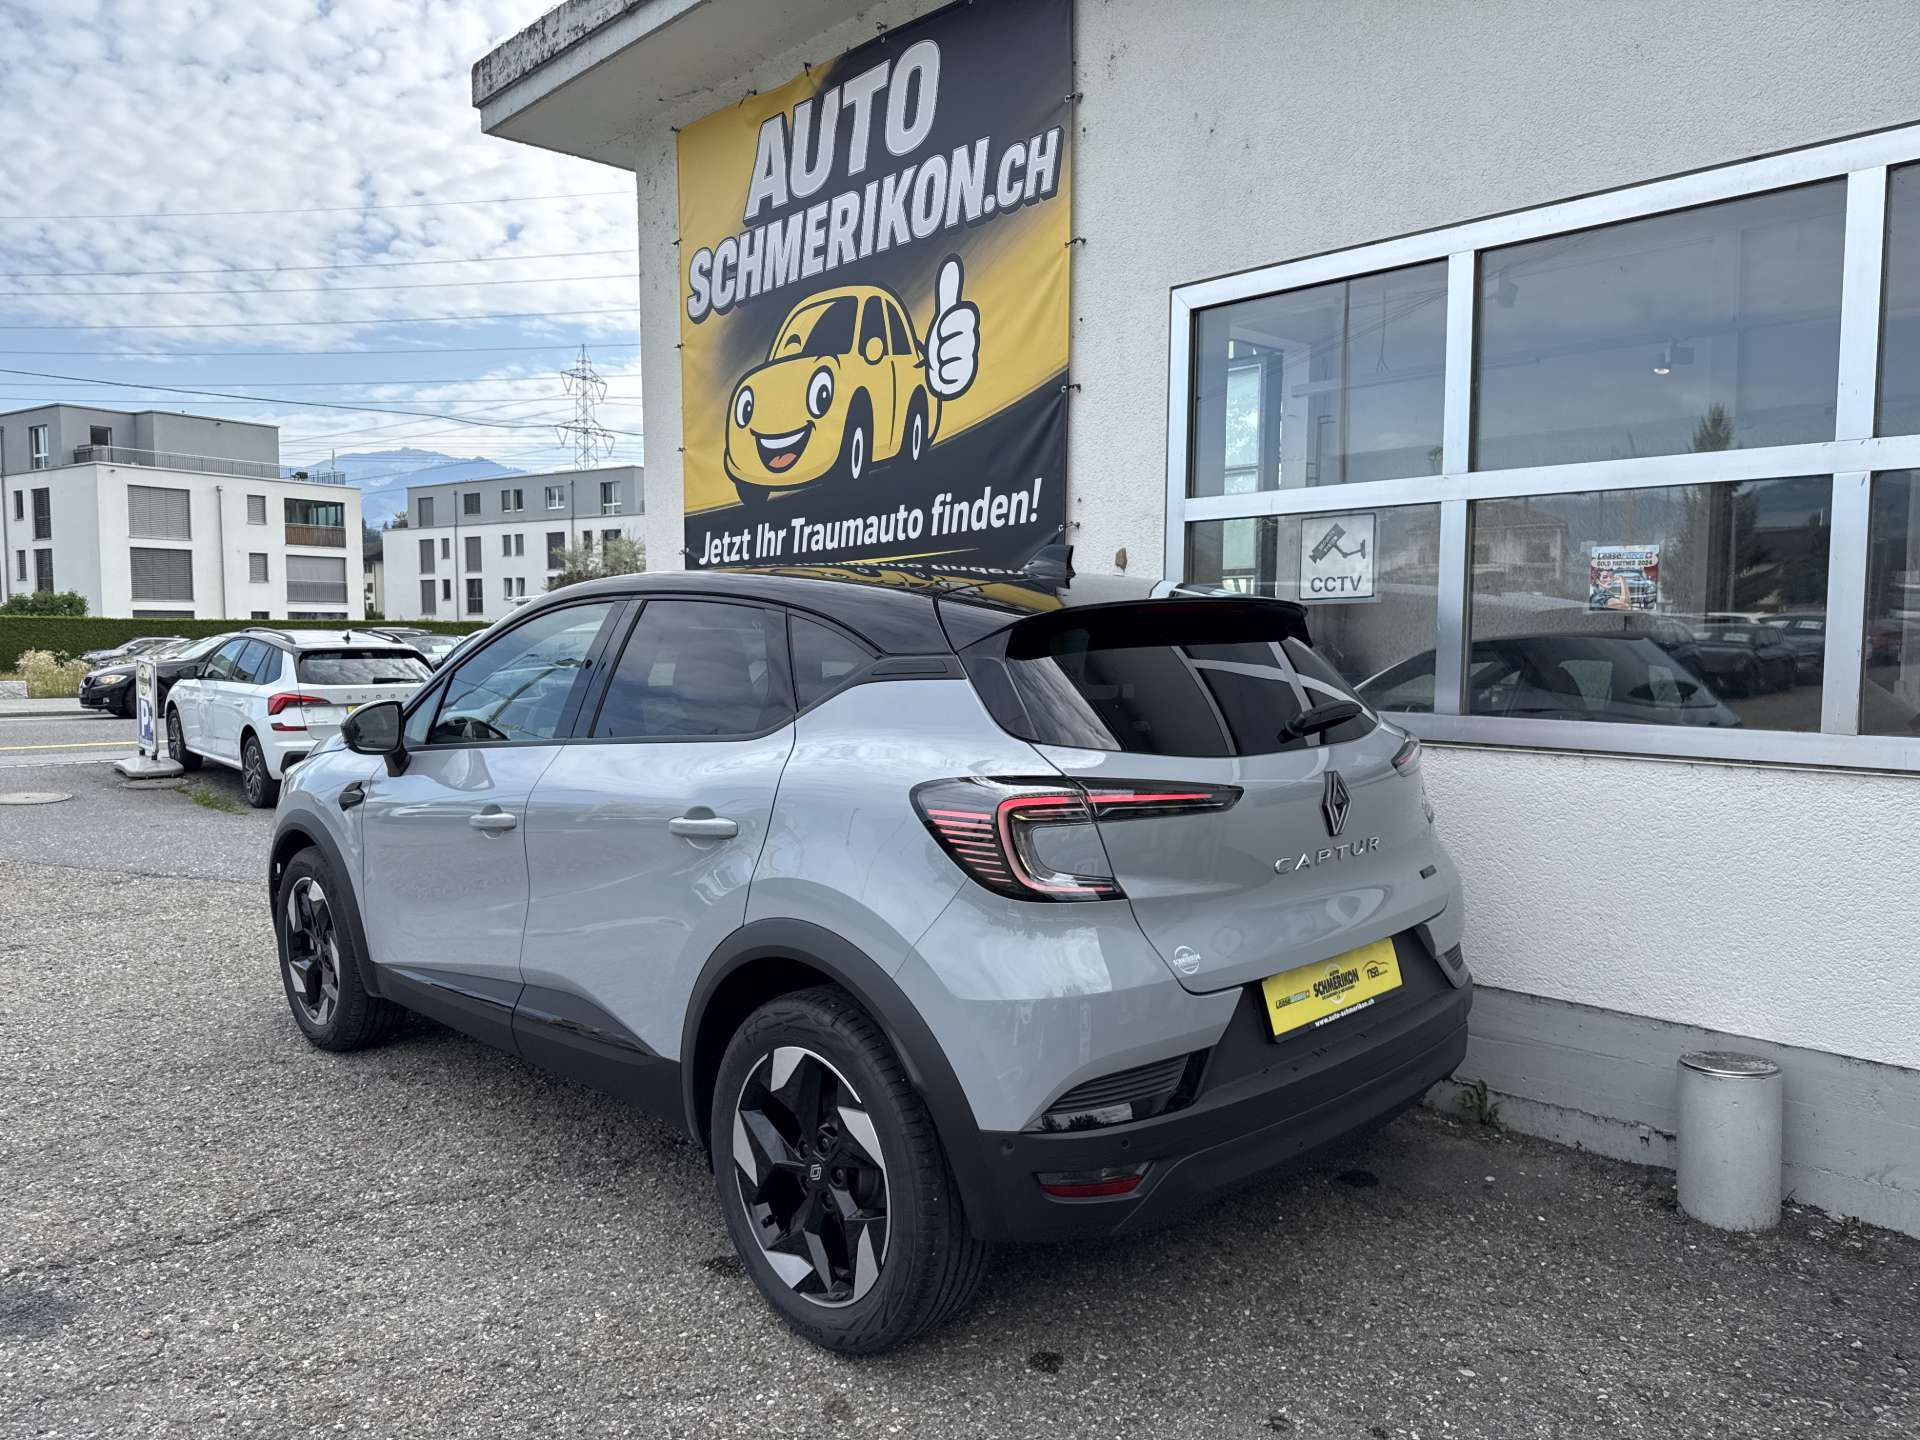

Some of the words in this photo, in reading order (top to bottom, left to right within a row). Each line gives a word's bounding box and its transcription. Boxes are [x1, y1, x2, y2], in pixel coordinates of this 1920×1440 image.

[744, 39, 941, 223] AUTO
[687, 127, 1063, 319] SCHMERIKON.CH
[699, 524, 750, 566] Jetzt
[755, 522, 786, 557] Ihr
[791, 504, 923, 554] Traumauto
[931, 477, 1043, 537] finden!
[1310, 575, 1362, 593] CCTV
[1273, 836, 1381, 876] CAPTUR
[1313, 969, 1359, 997] SCHMERIKON
